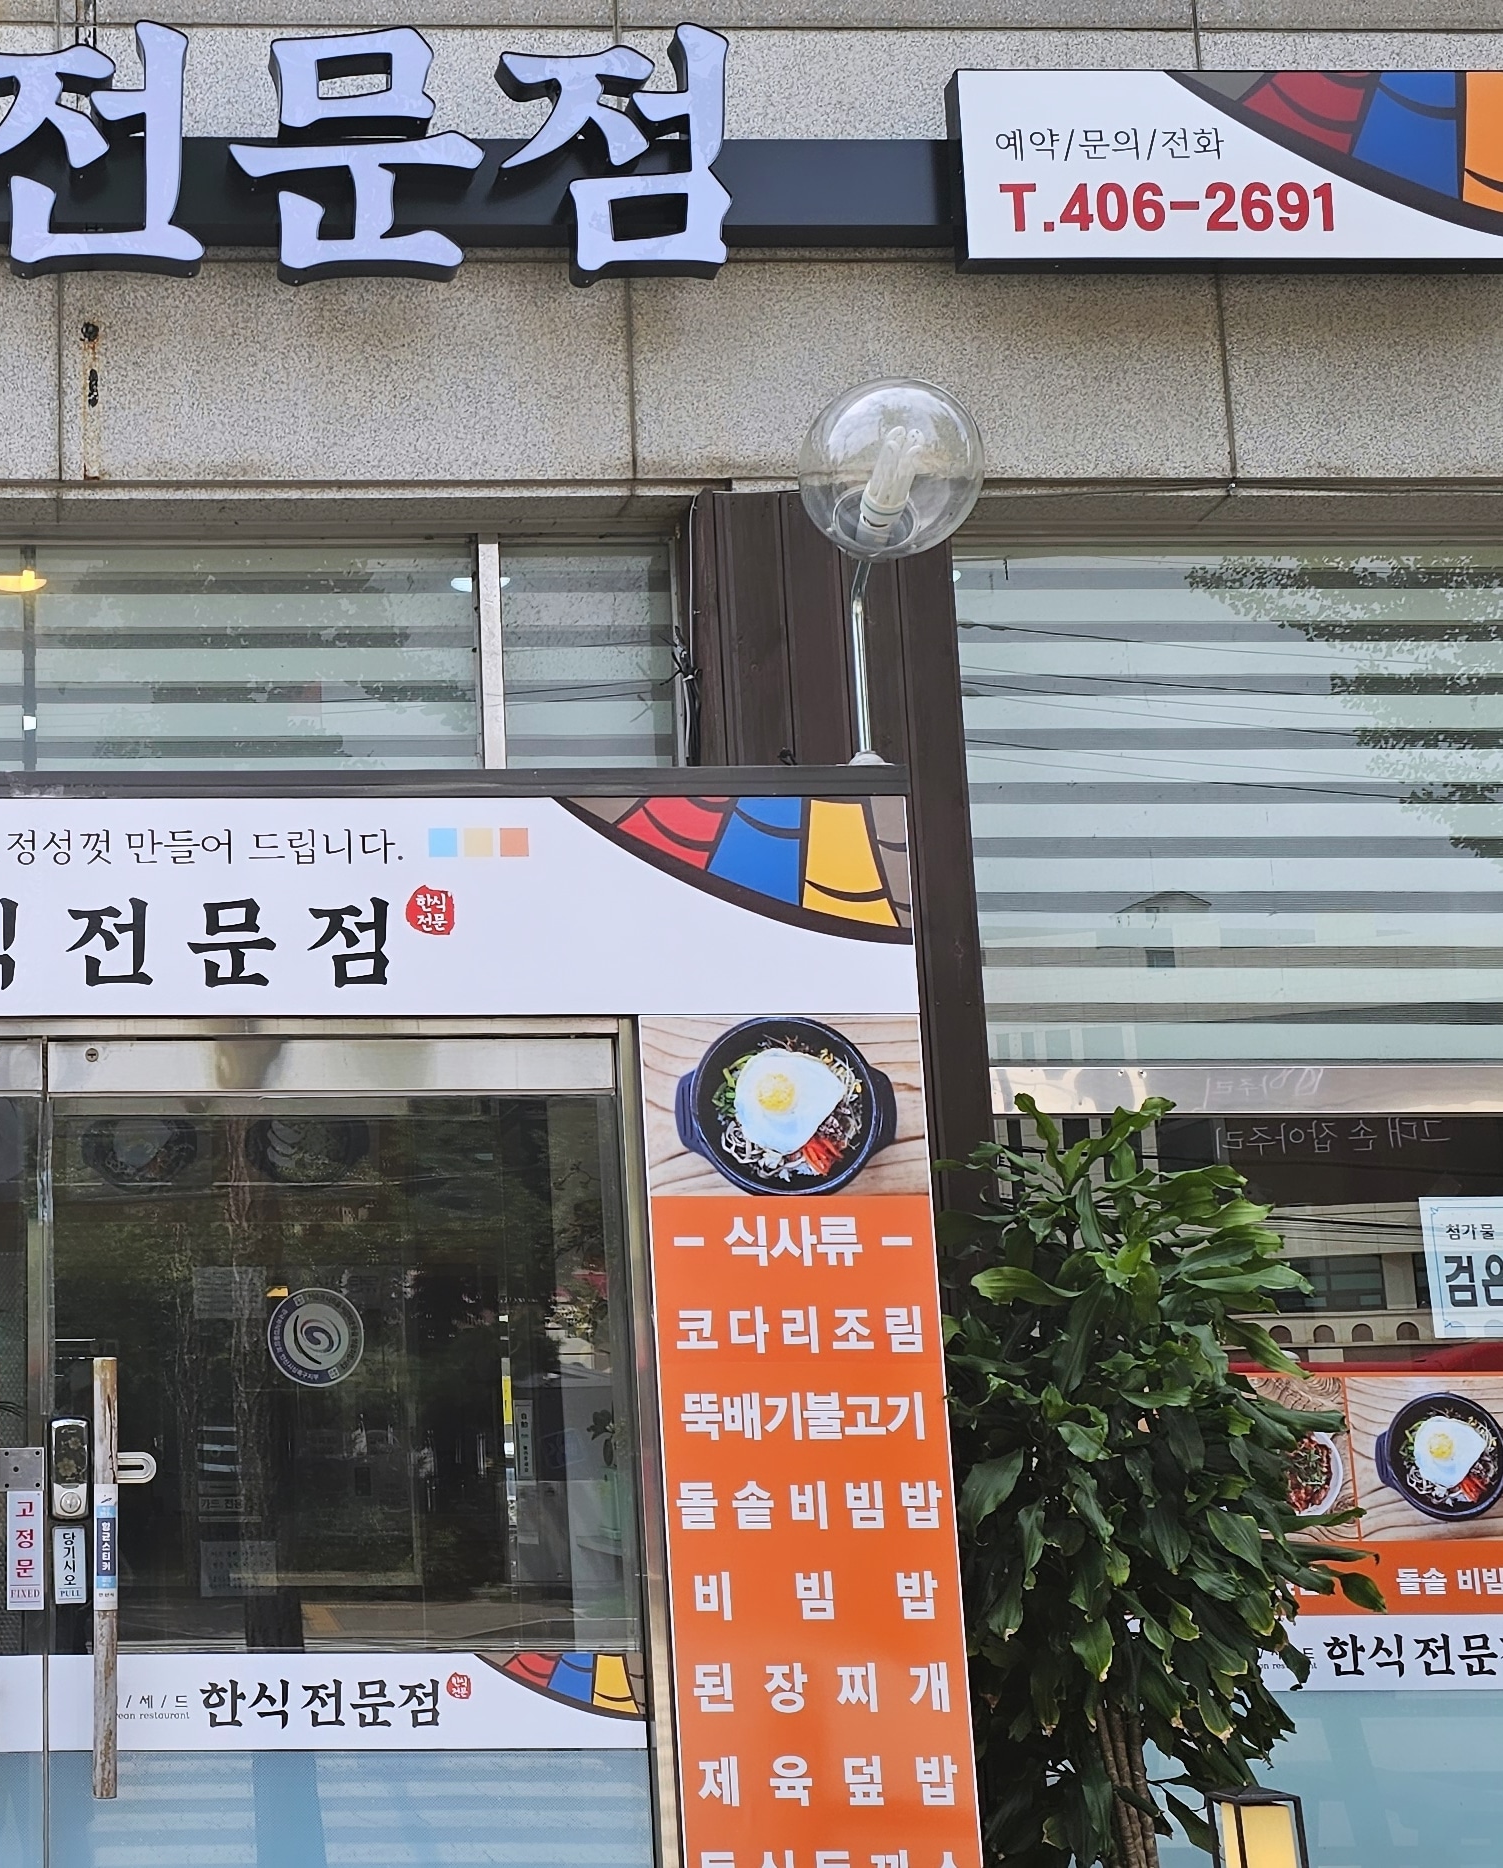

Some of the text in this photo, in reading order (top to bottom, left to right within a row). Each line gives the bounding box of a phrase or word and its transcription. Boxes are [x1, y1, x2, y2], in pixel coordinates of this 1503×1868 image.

[995, 128, 1225, 161] 예약/문의/전화
[999, 182, 1335, 233] T.406-2691
[7, 828, 113, 866] 정성껏
[126, 828, 233, 866] 만들어
[249, 828, 404, 866] 드립니다.
[415, 892, 447, 912] 한식
[415, 913, 448, 932] 전문
[723, 1215, 863, 1267] 식사류
[1445, 1223, 1495, 1240] 첨가물
[676, 1305, 923, 1354] 코다리조림
[680, 1392, 926, 1441] 뚝배기불고기
[675, 1480, 943, 1530] 돌솥비빔밥
[15, 1501, 35, 1578] 고정문
[63, 1532, 77, 1586] 당기시오
[10, 1590, 40, 1599] FIXED
[693, 1570, 939, 1621] 비빔밥
[1395, 1567, 1447, 1595] 돌솥
[1323, 1633, 1503, 1678] 한식전문
[693, 1662, 951, 1714] 된장찌개
[139, 1711, 190, 1719] restaurant
[698, 1755, 958, 1807] 제육덮밥
